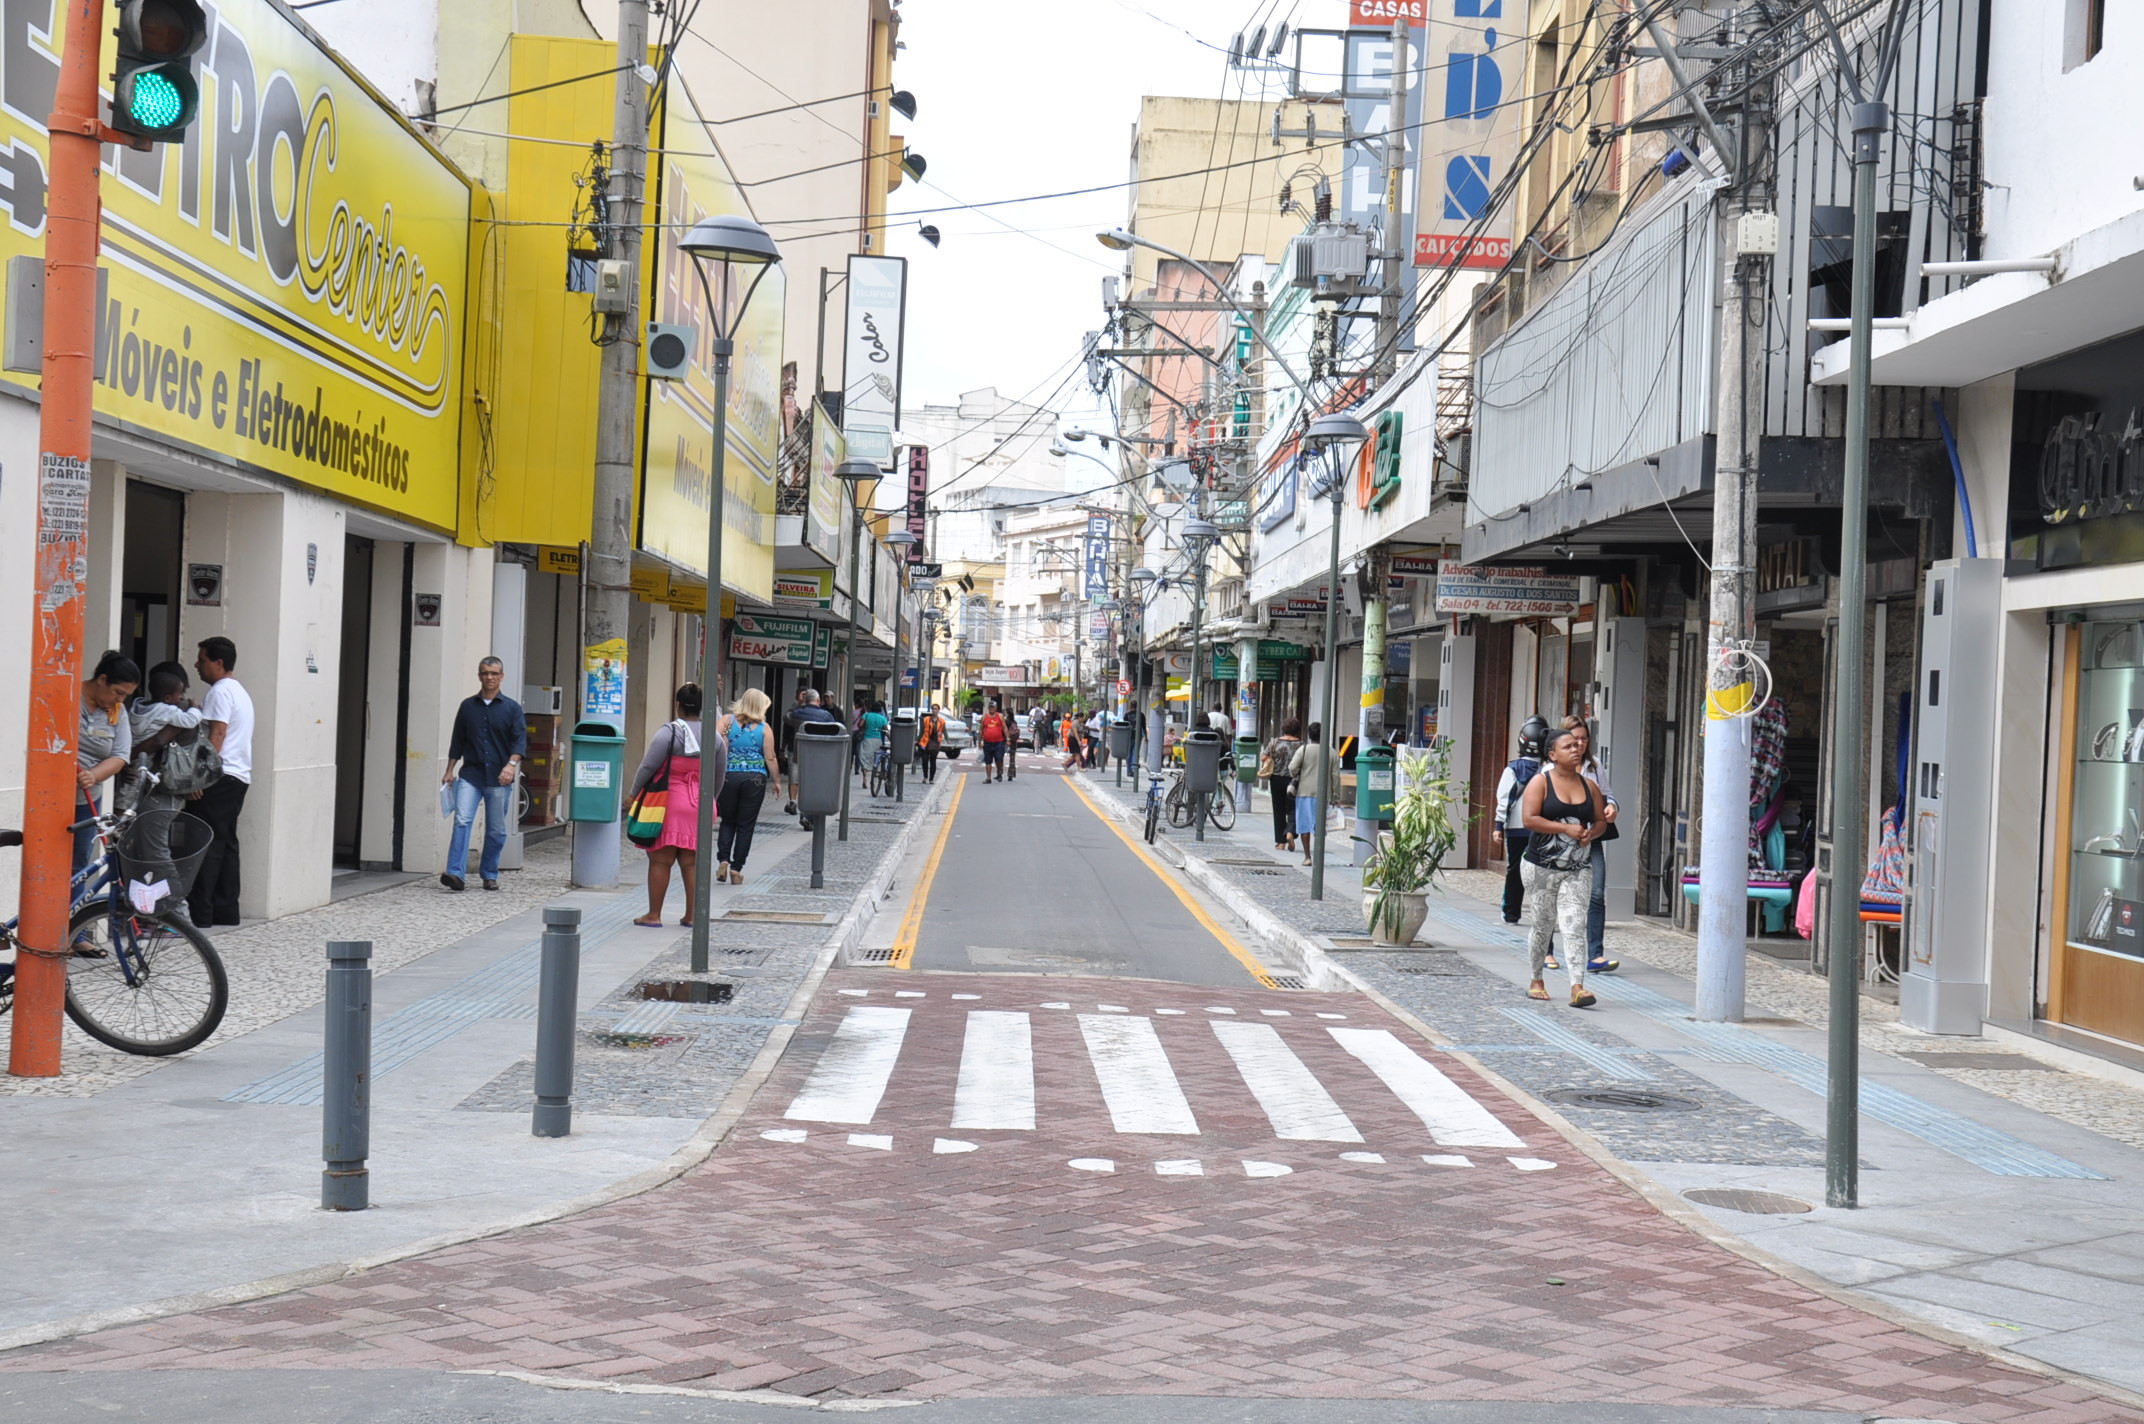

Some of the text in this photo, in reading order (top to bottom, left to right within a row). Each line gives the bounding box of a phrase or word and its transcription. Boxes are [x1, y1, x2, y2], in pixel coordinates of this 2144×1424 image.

[1360, 2, 1421, 17] CASAS
[211, 370, 228, 429] e
[235, 357, 409, 494] Eletrodomésticos
[549, 551, 578, 565] ELETR
[1395, 561, 1433, 571] BAHIA
[777, 583, 816, 593] SILVEIRA
[1493, 578, 1527, 587] COMERCIAL
[1537, 580, 1572, 588] CRIMINAL
[1452, 587, 1479, 596] CESAR
[1479, 588, 1516, 597] AUGUSTO
[1527, 590, 1543, 599] DOS
[1544, 590, 1578, 600] SANTOS
[1441, 599, 1463, 609] Sala
[1463, 599, 1480, 610] 04
[763, 621, 808, 633] FUJIFILM
[760, 644, 787, 658] Color
[1258, 646, 1285, 656] CYBER
